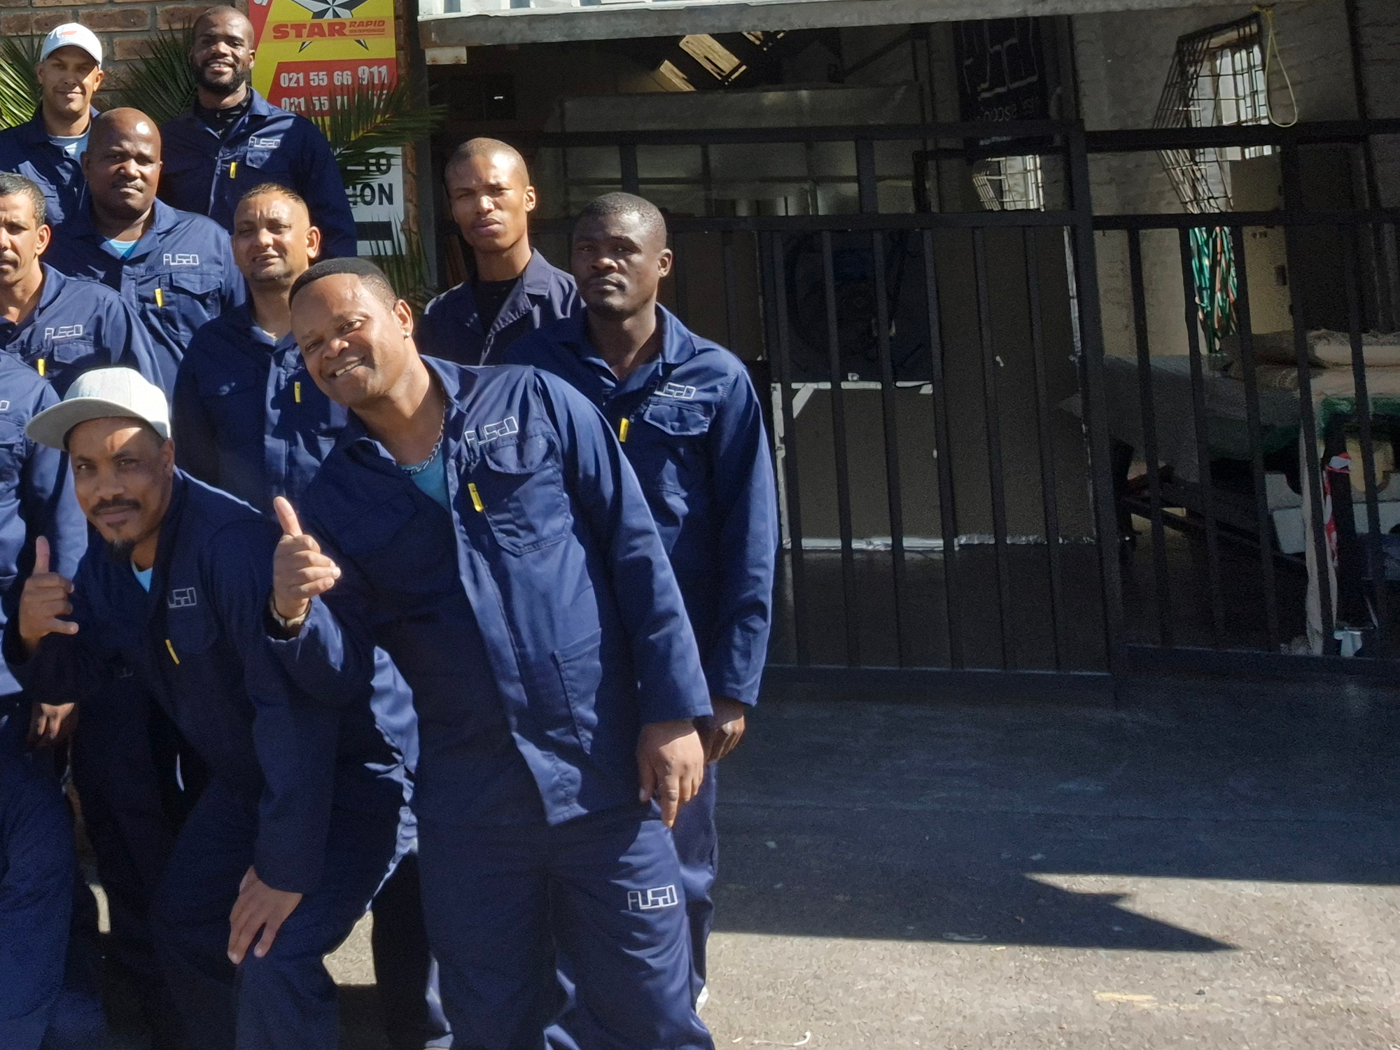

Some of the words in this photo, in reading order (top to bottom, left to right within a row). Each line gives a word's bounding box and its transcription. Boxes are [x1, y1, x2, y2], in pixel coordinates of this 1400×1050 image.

[272, 21, 347, 40] STAR
[349, 19, 386, 28] RAPID
[280, 72, 304, 88] 021
[309, 71, 328, 86] 55
[333, 70, 352, 86] 66
[358, 65, 388, 85] 911
